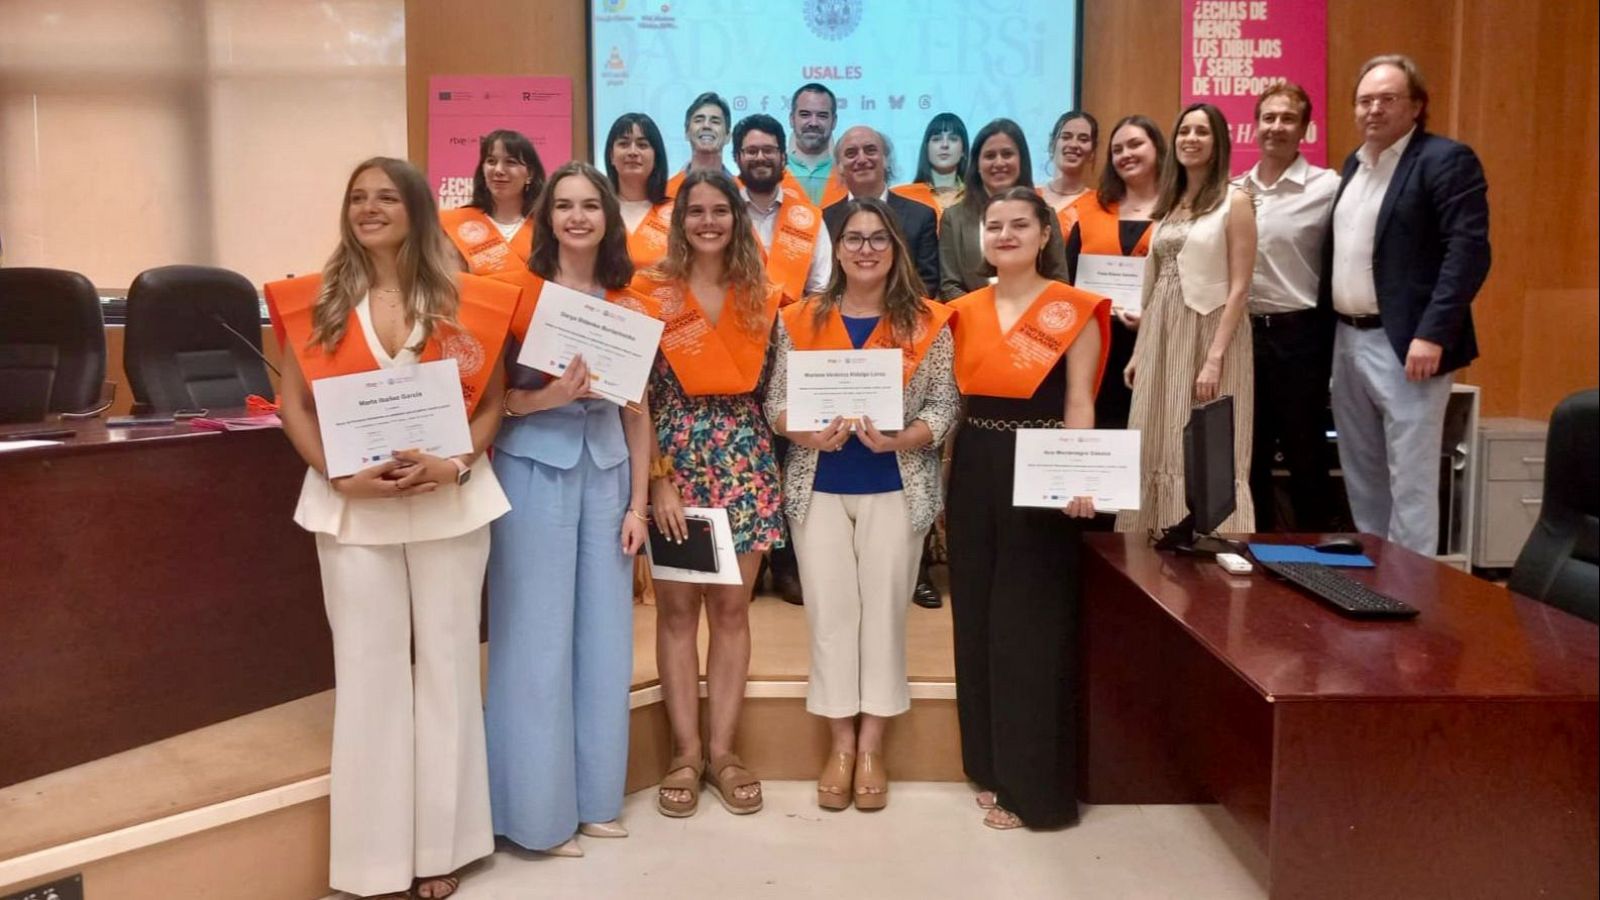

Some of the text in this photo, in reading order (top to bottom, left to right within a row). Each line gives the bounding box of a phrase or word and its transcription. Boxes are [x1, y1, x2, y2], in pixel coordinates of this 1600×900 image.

[1194, 1, 1267, 20] ¿ECHAS DE
[1193, 20, 1242, 38] MENOS
[1193, 39, 1282, 58] LOS DIBUJOS
[802, 66, 862, 79] USAL.ES
[1193, 58, 1254, 76] Y SERIES
[1192, 77, 1210, 96] DE
[1213, 77, 1231, 96] TU
[439, 177, 475, 196] ¿ECH
